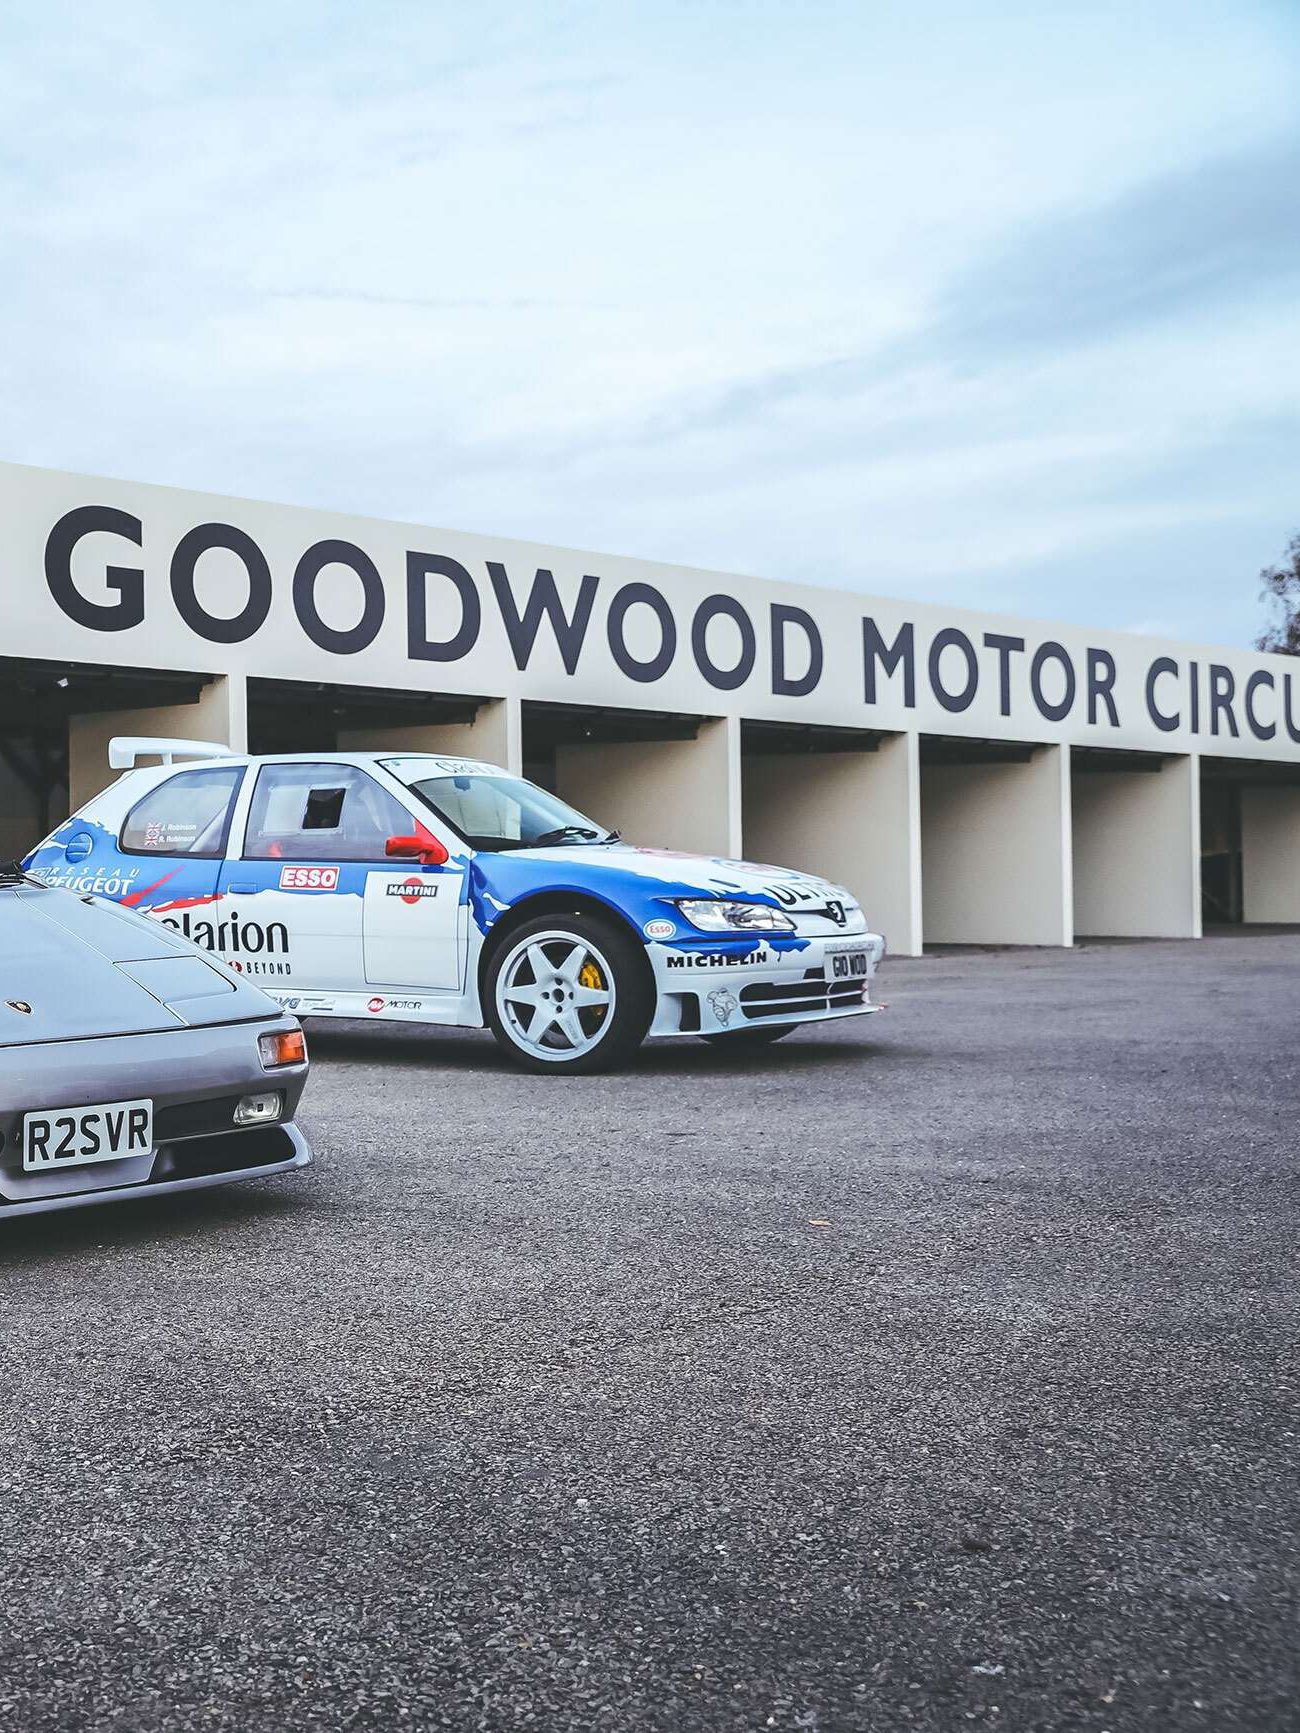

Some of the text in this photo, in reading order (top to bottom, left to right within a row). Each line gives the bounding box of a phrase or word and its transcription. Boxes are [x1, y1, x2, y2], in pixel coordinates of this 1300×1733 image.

[44, 505, 824, 697] GOODWOOD
[862, 616, 1120, 728] MOTOR
[49, 866, 141, 877] RESEAU
[282, 868, 336, 887] ESSO
[388, 885, 436, 896] MARTINI
[667, 952, 767, 968] MICHELIN
[246, 961, 292, 975] BEYOND
[386, 1000, 422, 1010] MOTOR
[28, 1108, 149, 1163] R2SVR
